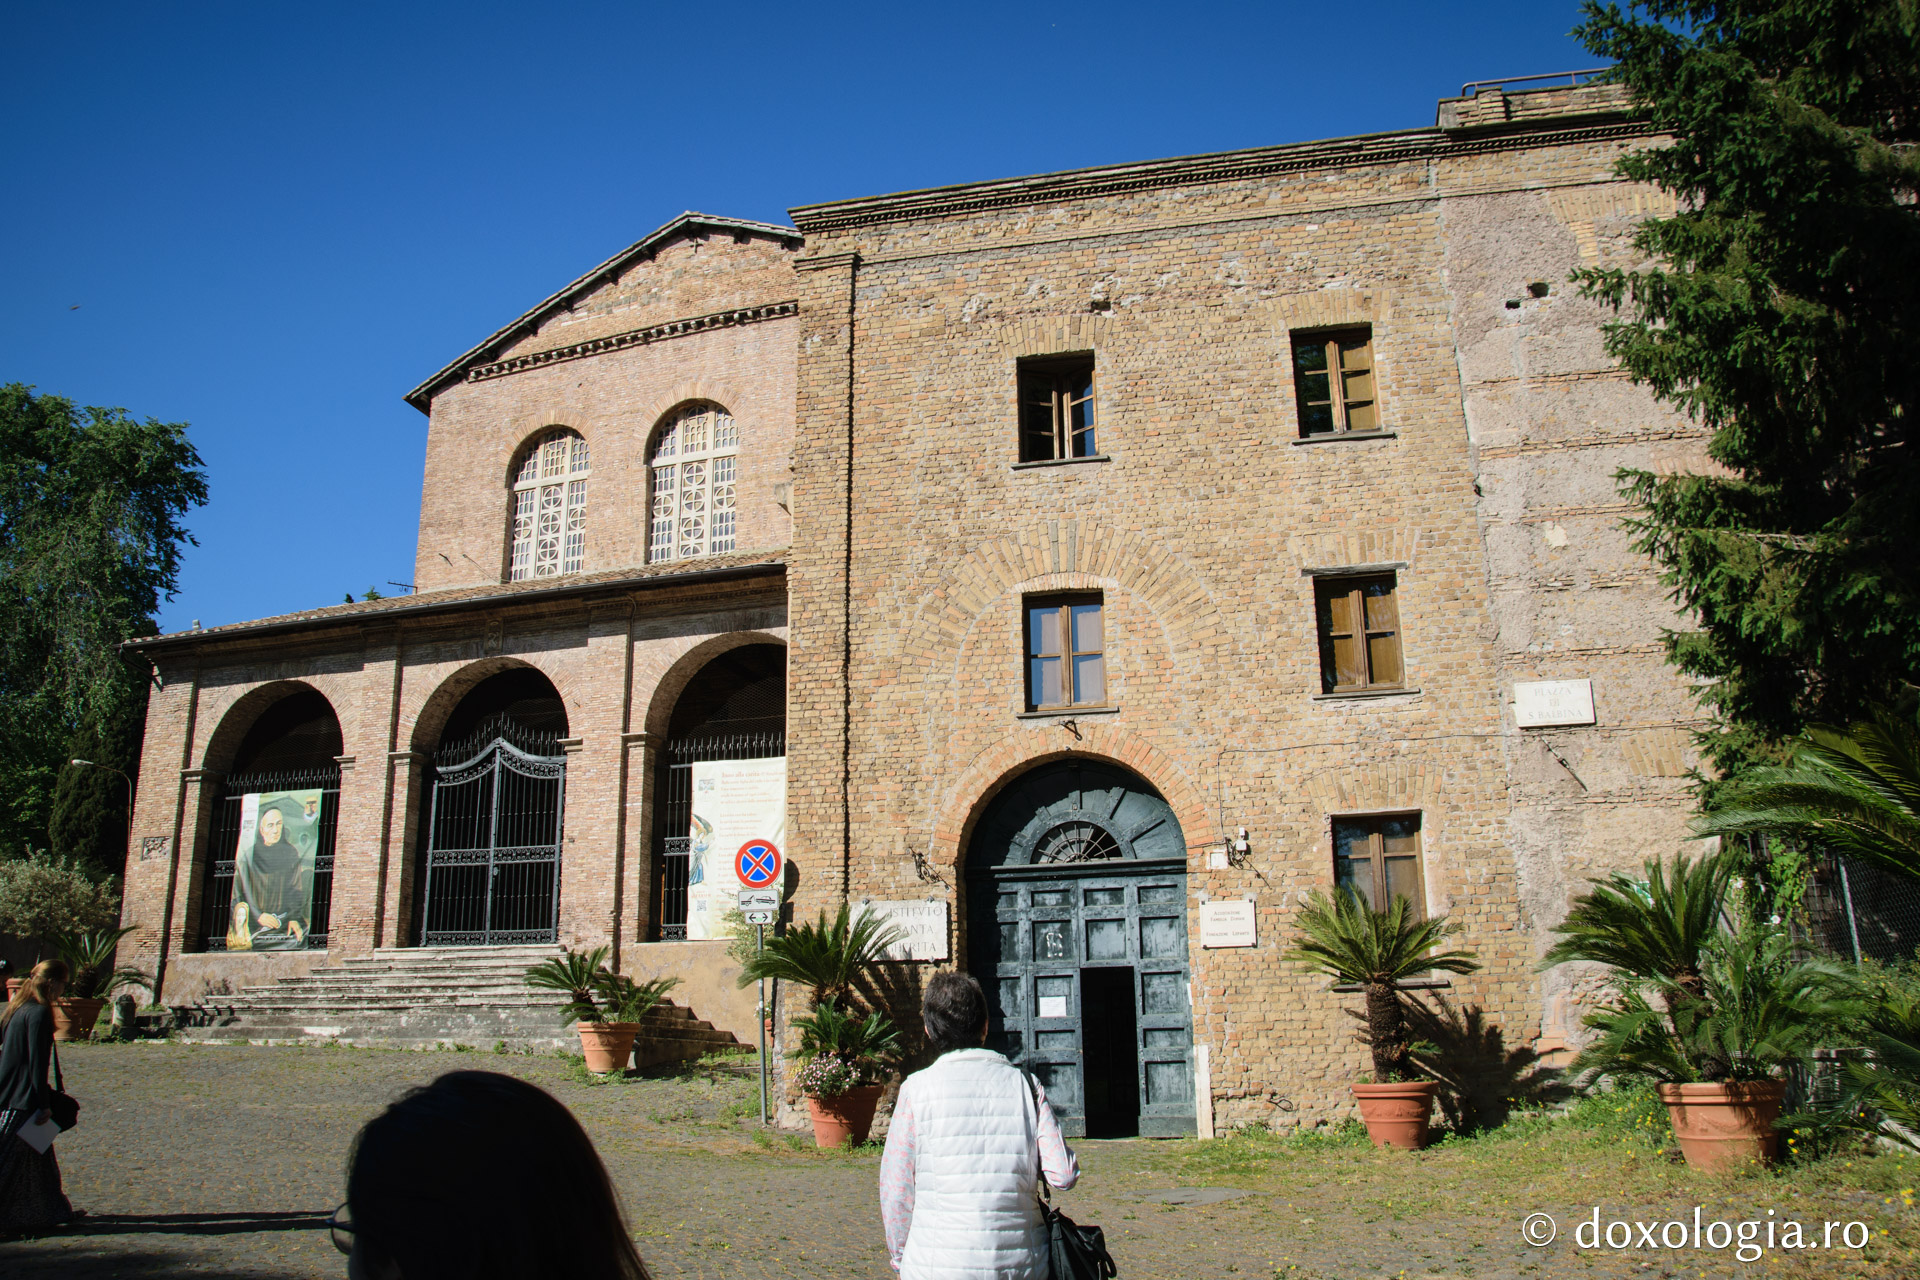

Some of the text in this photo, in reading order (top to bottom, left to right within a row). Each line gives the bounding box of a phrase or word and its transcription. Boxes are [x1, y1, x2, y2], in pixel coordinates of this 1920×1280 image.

[1533, 687, 1573, 697] PIAZZA
[1549, 698, 1560, 707] DI
[1538, 709, 1583, 719] BALBINA
